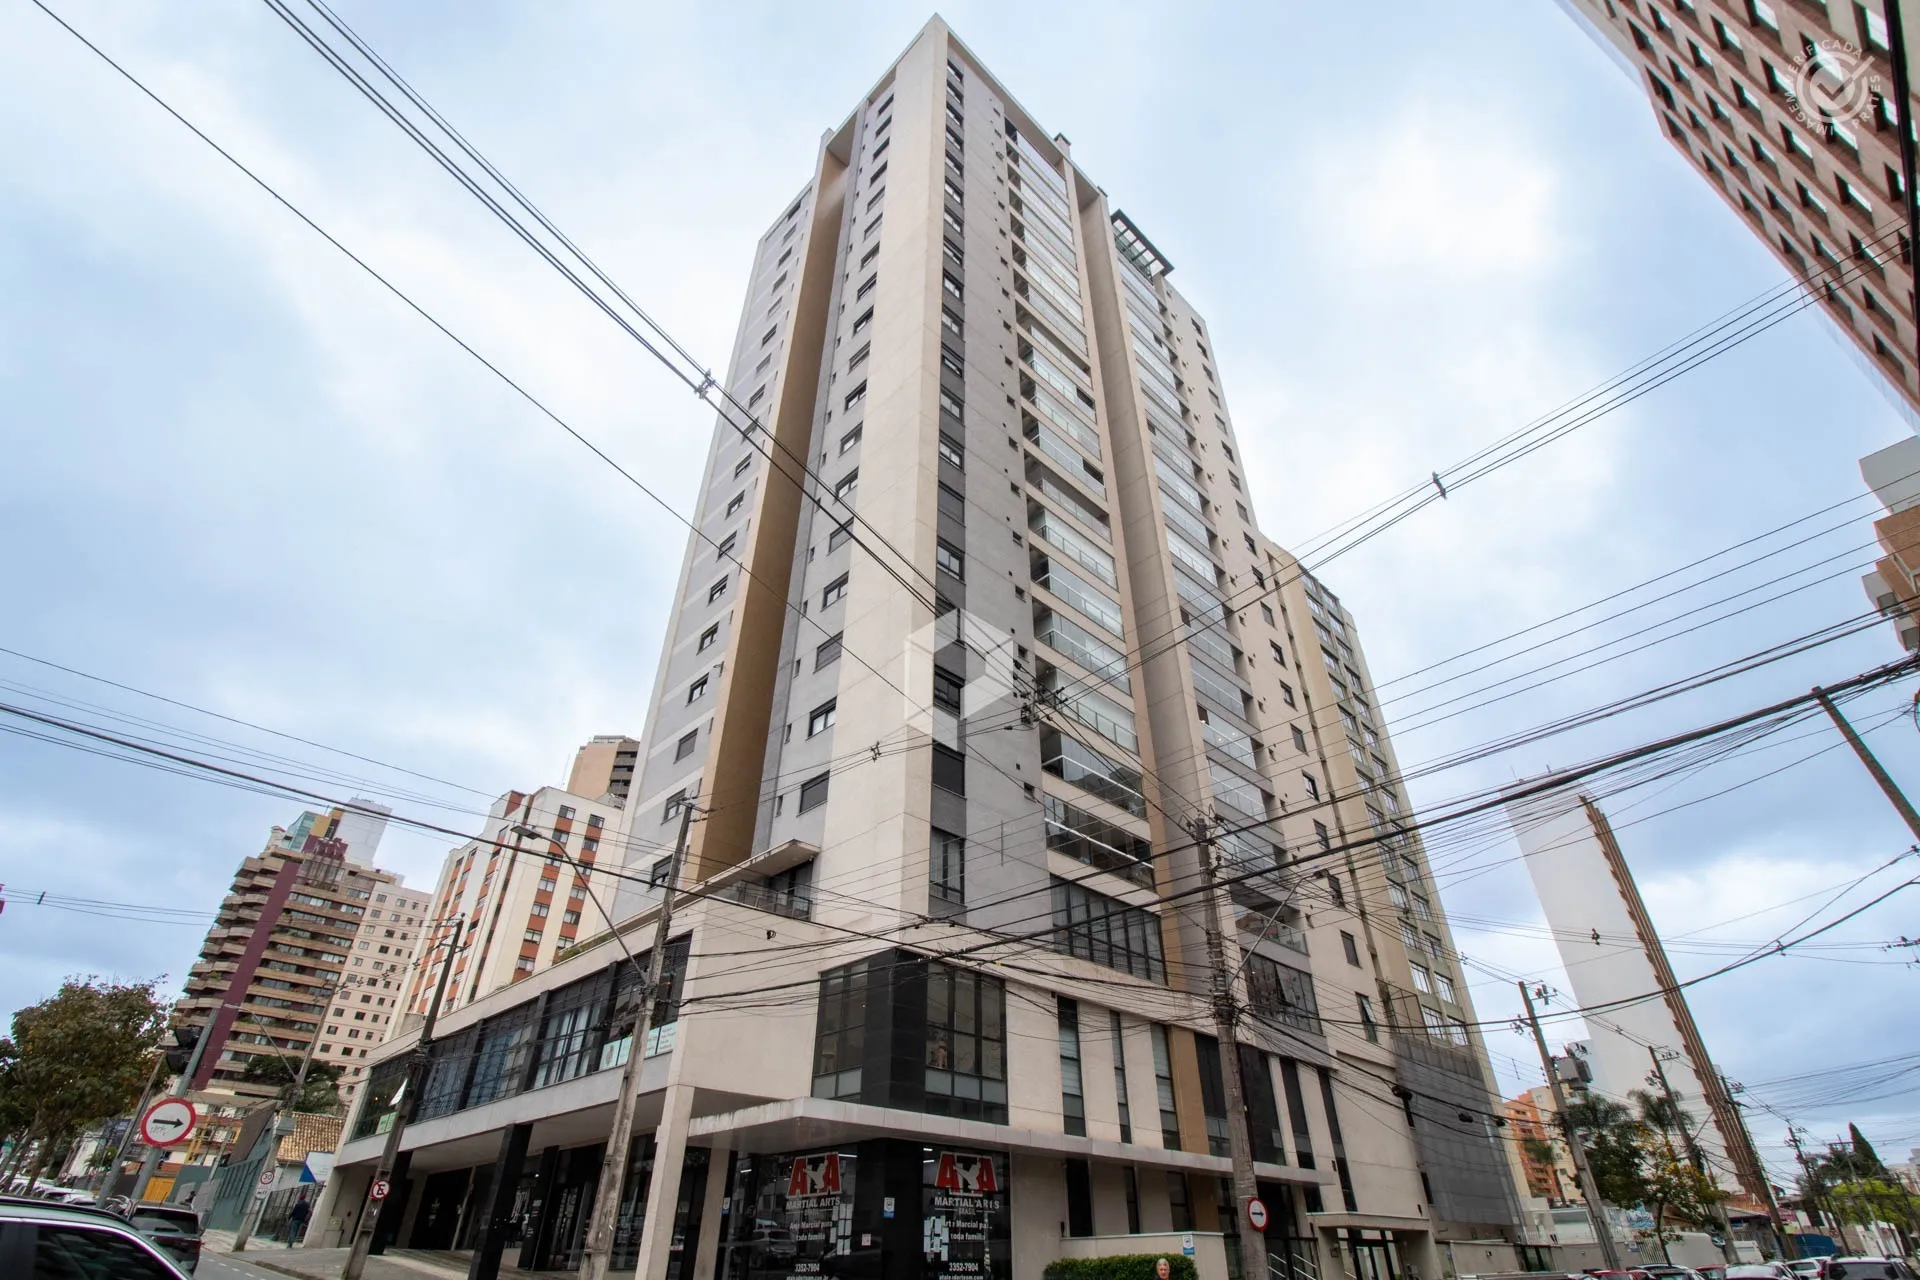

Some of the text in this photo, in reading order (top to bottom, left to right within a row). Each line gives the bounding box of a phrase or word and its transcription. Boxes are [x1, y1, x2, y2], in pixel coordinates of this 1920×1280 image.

[785, 1197, 841, 1210] MARTIAL ARTS
[934, 1196, 974, 1208] MARTIAL
[956, 1220, 979, 1228] Marcial
[950, 1232, 964, 1241] toda
[948, 1262, 979, 1272] 3352-7904
